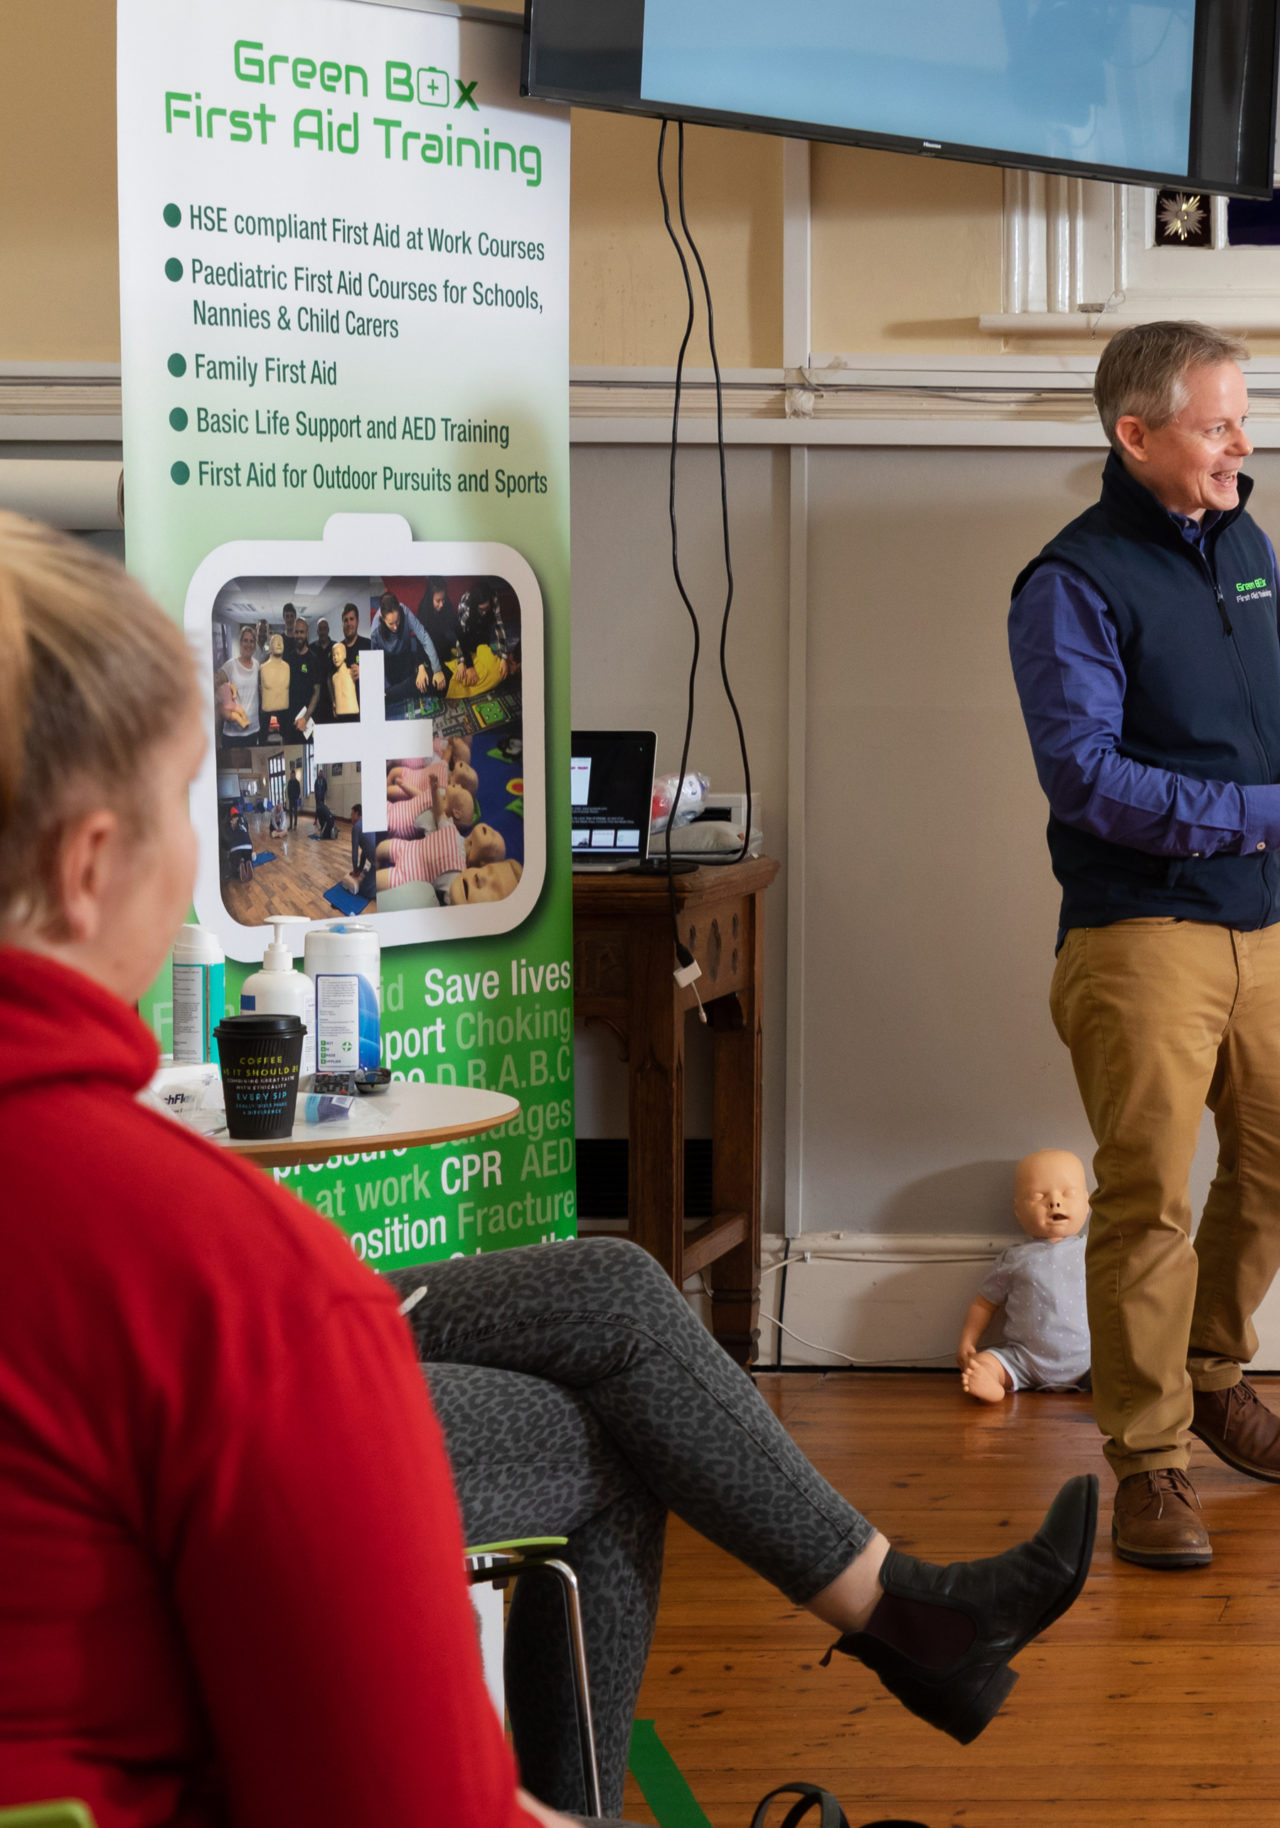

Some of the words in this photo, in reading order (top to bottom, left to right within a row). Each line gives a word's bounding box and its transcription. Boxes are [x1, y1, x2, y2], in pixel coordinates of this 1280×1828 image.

[234, 39, 368, 97] Green
[164, 91, 276, 145] First
[294, 108, 359, 155] Aid
[373, 117, 542, 187] Training
[190, 204, 227, 233] HSE
[234, 213, 327, 243] compliant
[332, 218, 368, 246] First
[373, 222, 400, 249] Aid
[406, 227, 423, 251] at
[428, 228, 472, 255] Work
[478, 232, 545, 261] Courses
[191, 258, 288, 290] Paediatric
[294, 266, 333, 294] First
[337, 270, 363, 297] Aid
[368, 273, 437, 303] Courses
[443, 279, 467, 305] for
[472, 281, 543, 313] Schools,
[193, 299, 271, 330] Nannies
[277, 305, 292, 331] &
[297, 306, 340, 334] Child
[345, 311, 399, 339] Carers
[195, 353, 258, 387] Family
[265, 357, 306, 385] First
[311, 360, 337, 386] Aid
[196, 407, 249, 434] Basic
[255, 409, 290, 436] Life
[295, 411, 361, 443] Support
[366, 415, 397, 440] and
[402, 416, 436, 441] AED
[441, 417, 510, 449] Training
[198, 460, 242, 488] First
[247, 461, 277, 488] Aid
[282, 462, 307, 488] for
[313, 463, 377, 490] Outdoor
[383, 466, 452, 492] Pursuits
[457, 469, 489, 493] and
[494, 469, 548, 498] Sports
[380, 973, 404, 1013] id
[424, 968, 499, 1007] Save
[511, 958, 571, 996] lives
[240, 1056, 282, 1065] COFFEE
[380, 1017, 446, 1069] port
[456, 1003, 571, 1050] Choking
[246, 1066, 290, 1077] SHOULD
[436, 1045, 571, 1091] DR.A.B.C
[236, 1092, 269, 1101] EVERY
[273, 1091, 287, 1100] SIP
[316, 1180, 346, 1219] at
[355, 1164, 431, 1211] work
[441, 1150, 502, 1196] CPR
[520, 1137, 573, 1182] AED
[346, 1213, 447, 1262] osition
[457, 1189, 575, 1240] Fracture
